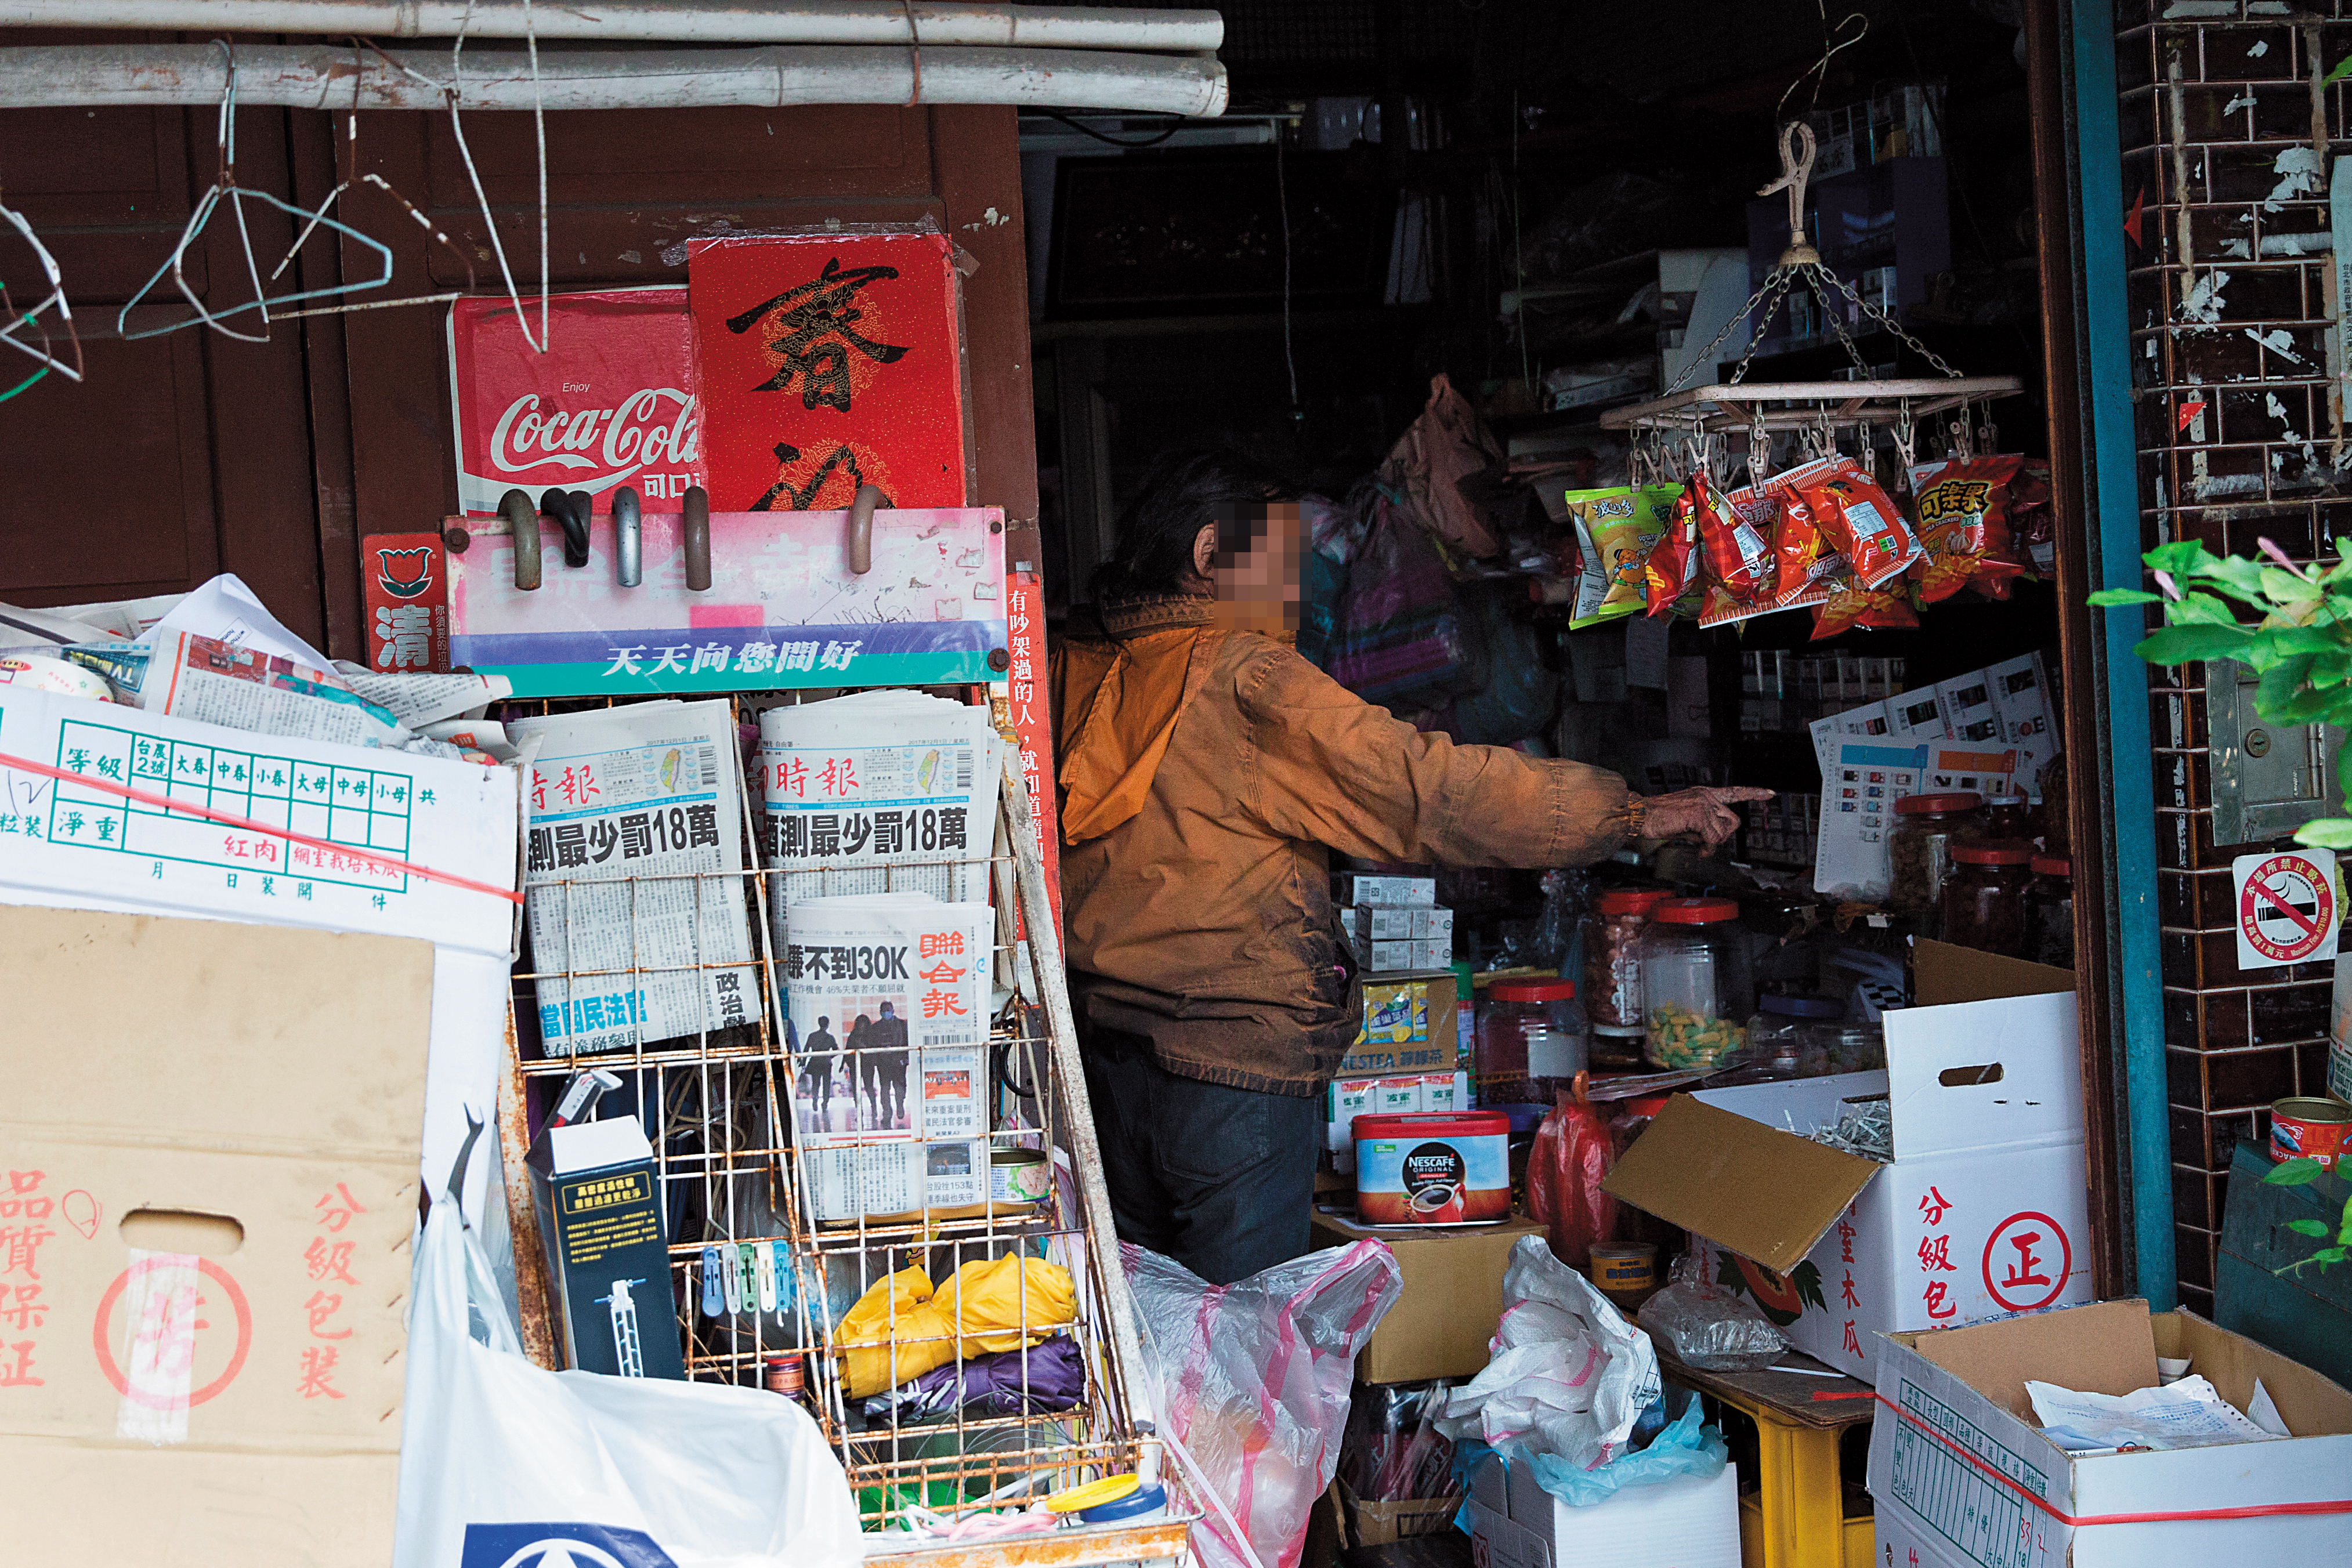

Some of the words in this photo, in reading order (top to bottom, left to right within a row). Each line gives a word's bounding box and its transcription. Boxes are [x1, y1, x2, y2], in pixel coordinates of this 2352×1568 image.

[563, 382, 590, 392] Enjoy
[642, 473, 700, 499] 可口
[137, 740, 168, 760] 台農
[67, 748, 124, 781] 等級
[137, 756, 168, 776] 2號
[176, 755, 208, 775] 大春
[218, 761, 248, 782] 中春
[256, 769, 286, 787] 小春
[297, 773, 328, 793] 大母
[337, 777, 368, 797] 中母
[765, 756, 859, 798] 時報
[376, 784, 407, 803] 小母
[419, 789, 436, 805] 共
[59, 812, 118, 841] 淨重
[224, 835, 277, 862] 紅肉
[152, 861, 162, 879] 月
[227, 873, 237, 888] 日
[262, 875, 276, 896] 裝
[298, 882, 312, 901] 開
[372, 893, 387, 911] 件
[919, 930, 968, 1019] 聯合報
[1409, 1153, 1455, 1167] NESCAFÉ
[1917, 1185, 1957, 1330] 分級包
[2001, 1230, 2051, 1288] 正
[295, 1182, 367, 1399] 分級包裝
[1837, 1201, 1865, 1359] 室木瓜
[2018, 1550, 2027, 1568] 18
